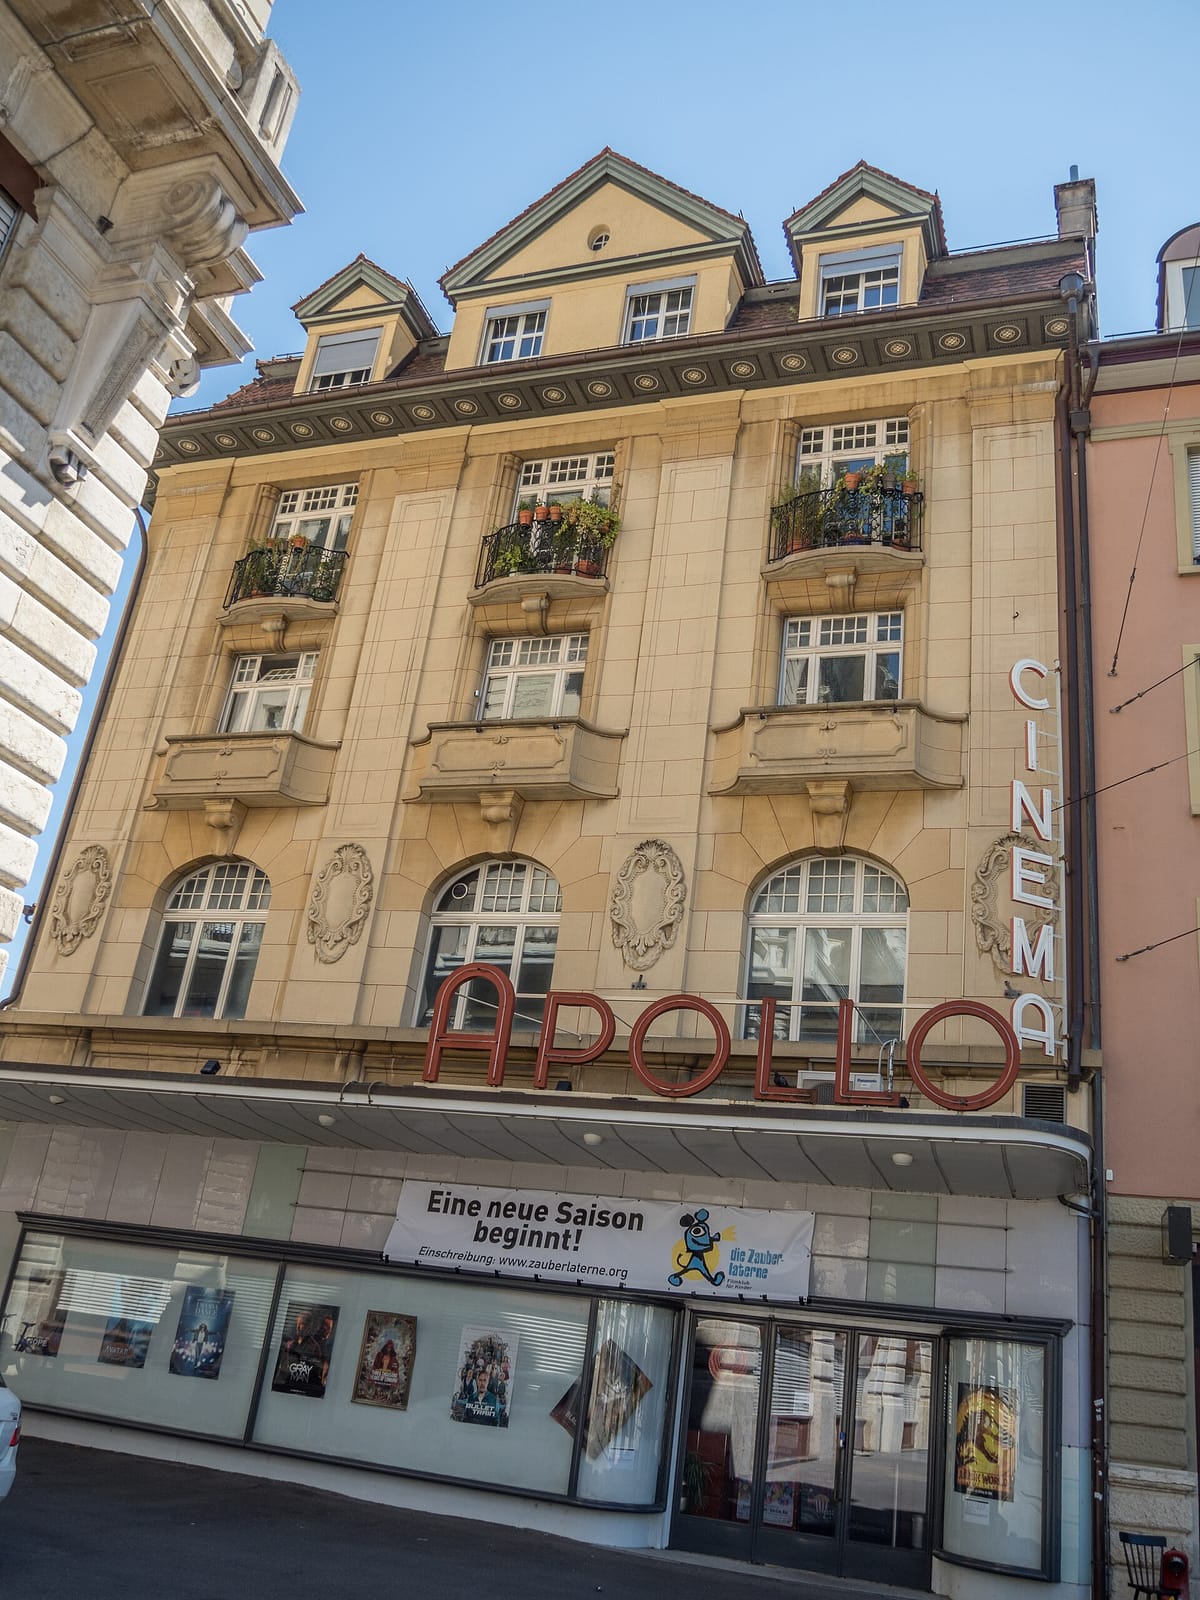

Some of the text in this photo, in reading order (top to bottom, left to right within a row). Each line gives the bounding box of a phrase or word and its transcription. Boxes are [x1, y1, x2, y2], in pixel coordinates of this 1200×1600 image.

[1009, 658, 1055, 1057] CINEMA
[422, 963, 1020, 1110] APOLLO
[427, 1190, 644, 1231] Eine neue Saison
[473, 1220, 583, 1252] beginnt!
[418, 1246, 628, 1280] Einschreibung: www.zauberlaterne.org
[728, 1262, 768, 1279] laterne
[730, 1248, 784, 1265] die Zauber-
[290, 1362, 313, 1374] GRAY
[465, 1402, 496, 1411] BULLET
